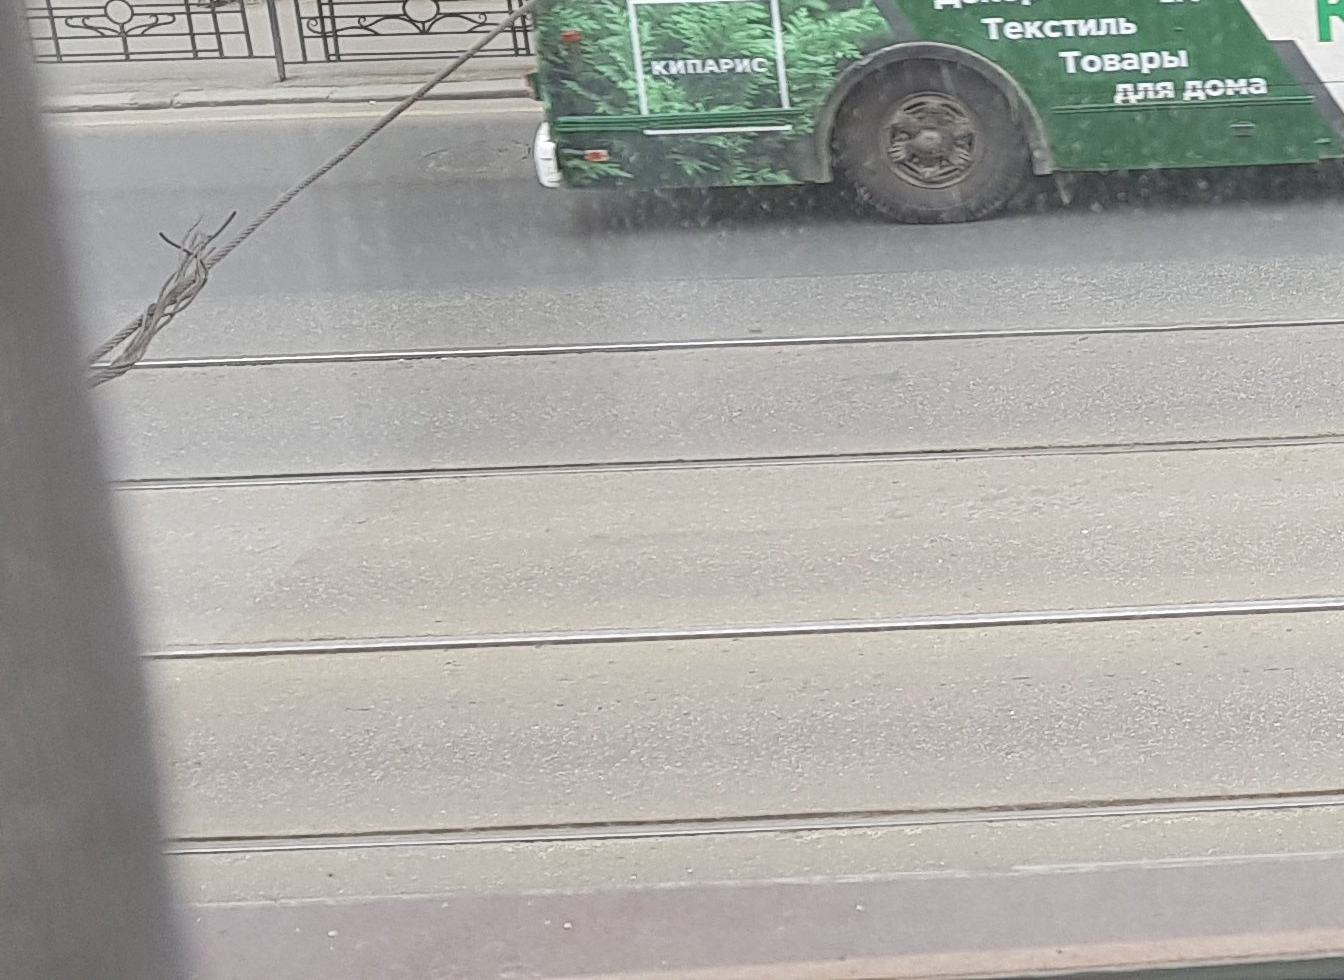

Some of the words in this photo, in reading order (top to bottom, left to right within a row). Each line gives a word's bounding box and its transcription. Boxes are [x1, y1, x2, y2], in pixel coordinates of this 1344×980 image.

[980, 16, 1138, 39] Текстиль
[650, 57, 769, 76] КИПАРИС
[1058, 49, 1189, 73] Товары
[1113, 80, 1175, 104] для
[1182, 75, 1268, 101] дома
